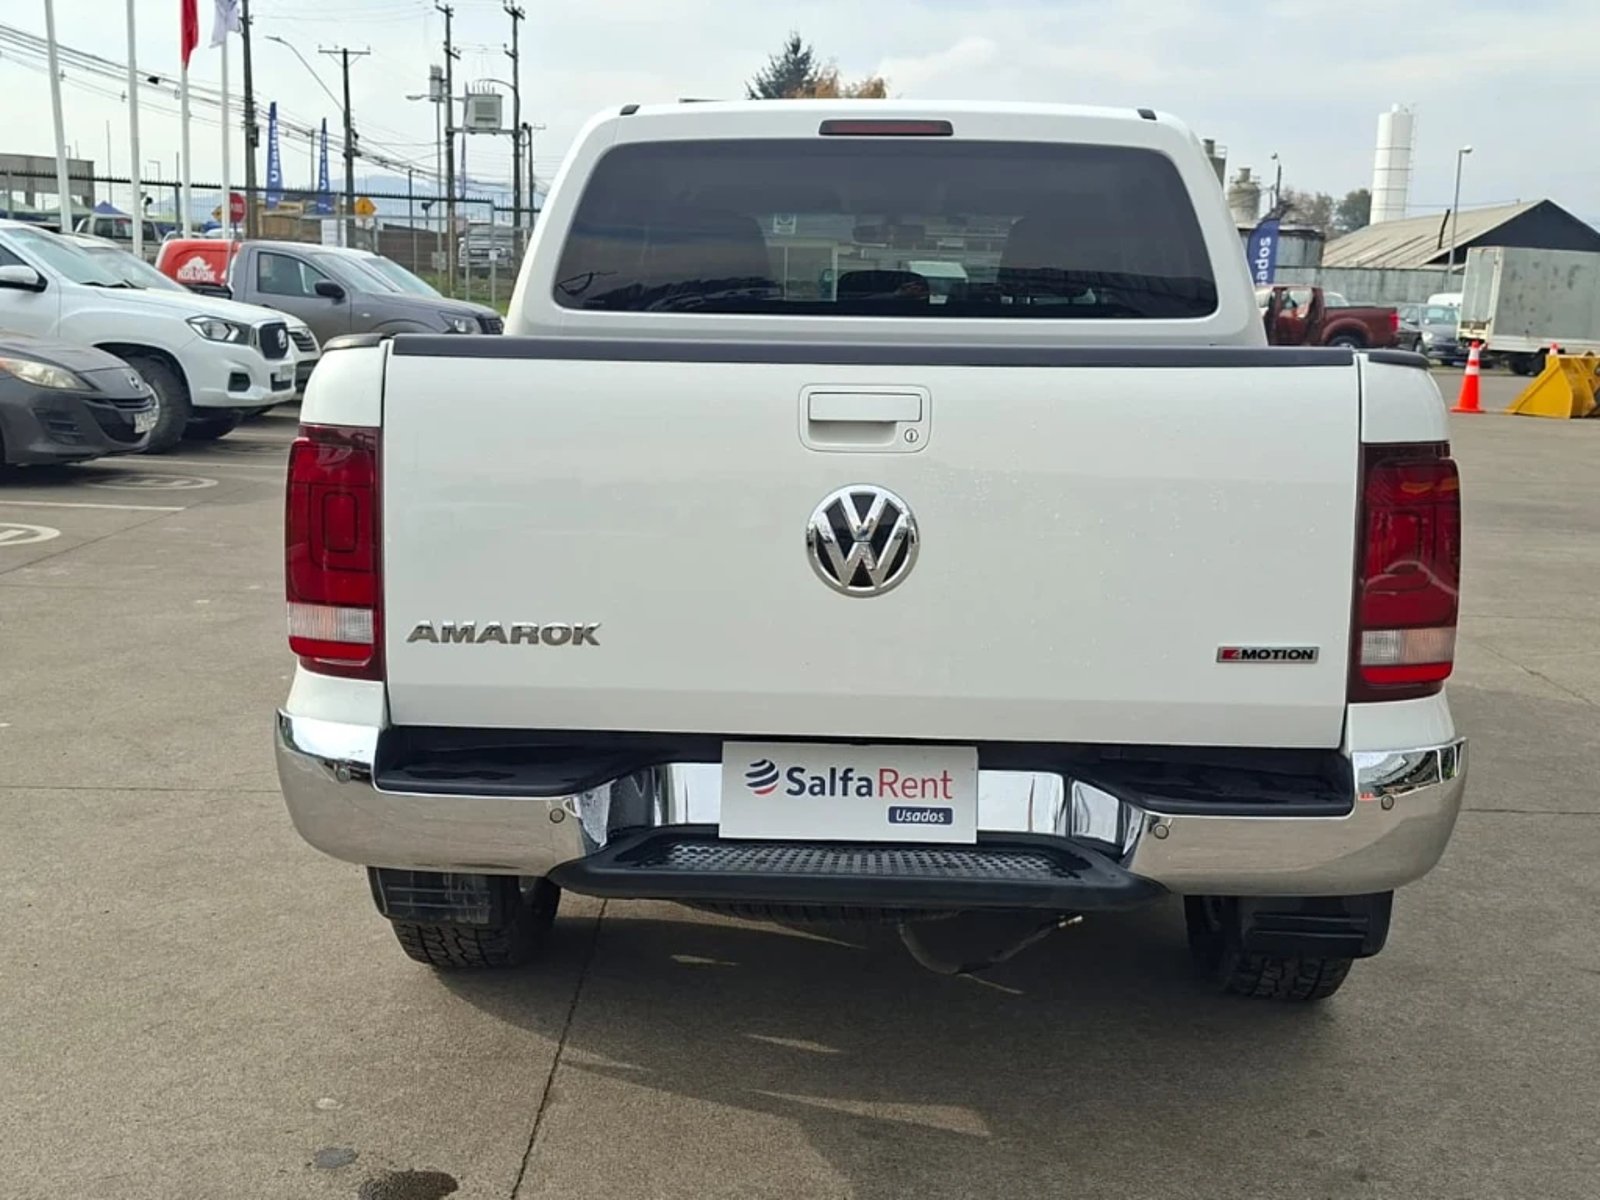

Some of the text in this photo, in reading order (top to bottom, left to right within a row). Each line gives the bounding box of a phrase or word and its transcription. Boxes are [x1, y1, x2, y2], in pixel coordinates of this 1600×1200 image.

[406, 620, 602, 646] AMAROK
[785, 766, 953, 800] SalfaRent
[895, 809, 945, 823] Usados
